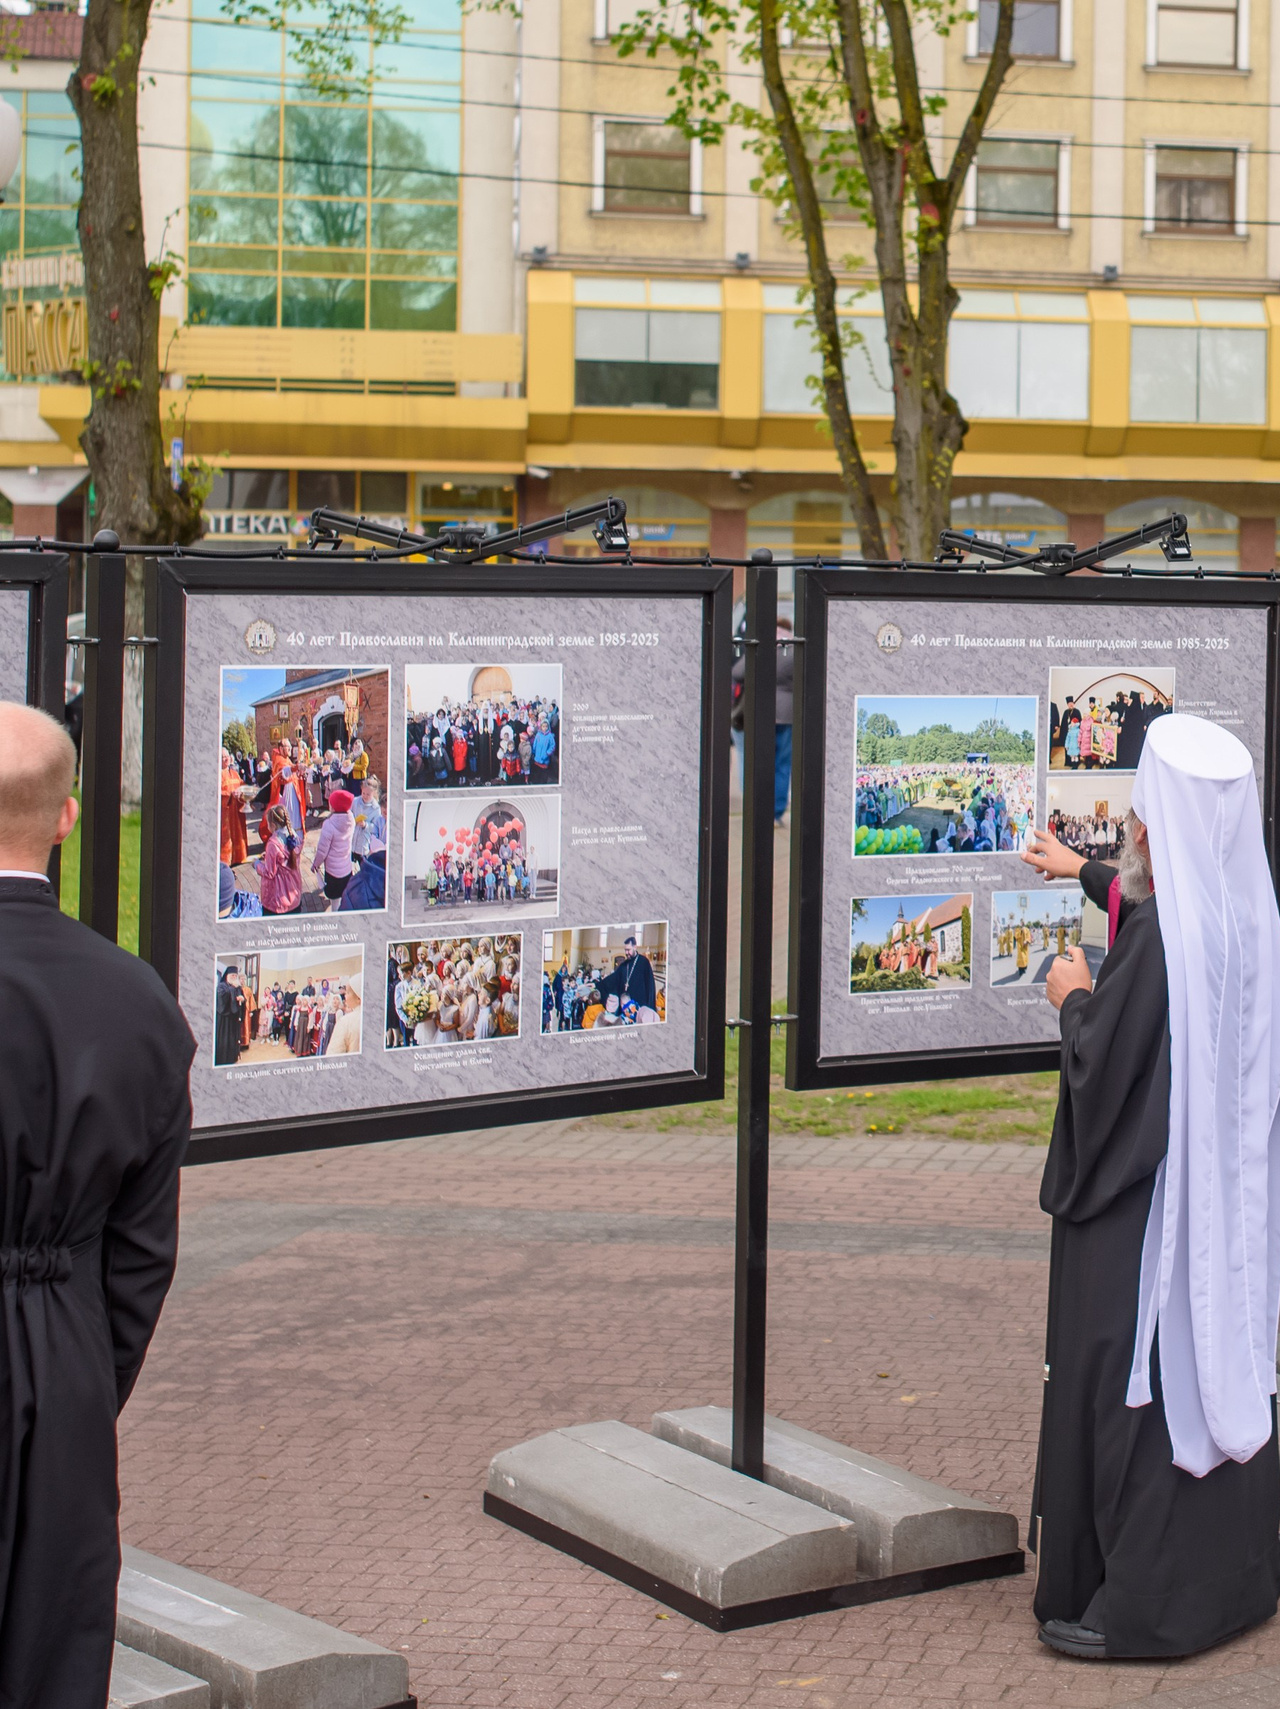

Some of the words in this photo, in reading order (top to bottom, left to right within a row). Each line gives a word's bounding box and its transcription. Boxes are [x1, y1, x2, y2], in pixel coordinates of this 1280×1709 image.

[286, 631, 305, 646] 40
[310, 634, 335, 646] лет
[340, 632, 423, 650] Православия
[429, 635, 443, 646] на
[448, 632, 554, 650] Калининградской
[558, 636, 595, 647] земле
[599, 632, 660, 646] 1985-2025
[910, 634, 926, 647] 40
[930, 637, 951, 647] лет
[955, 634, 1026, 650] Православия
[1029, 638, 1042, 647] на
[1046, 636, 1137, 651] Калининградской
[1141, 640, 1173, 649] земле
[1176, 638, 1230, 650] 1985-2025
[572, 827, 592, 835] Пасха
[601, 836, 615, 845] саду
[267, 924, 300, 935] Ученики
[302, 923, 311, 932] 19
[313, 923, 338, 932] школы
[246, 939, 256, 947] на
[258, 937, 302, 948] пасхальном
[304, 935, 339, 945] крестном
[341, 932, 359, 942] ходу
[414, 1051, 453, 1061] Освящение
[456, 1048, 476, 1058] храма
[227, 1071, 232, 1080] В
[235, 1068, 270, 1080] праздник
[273, 1064, 313, 1076] святителя
[317, 1061, 347, 1071] Николая
[414, 1061, 460, 1072] Константина
[470, 1057, 492, 1066] Елены
